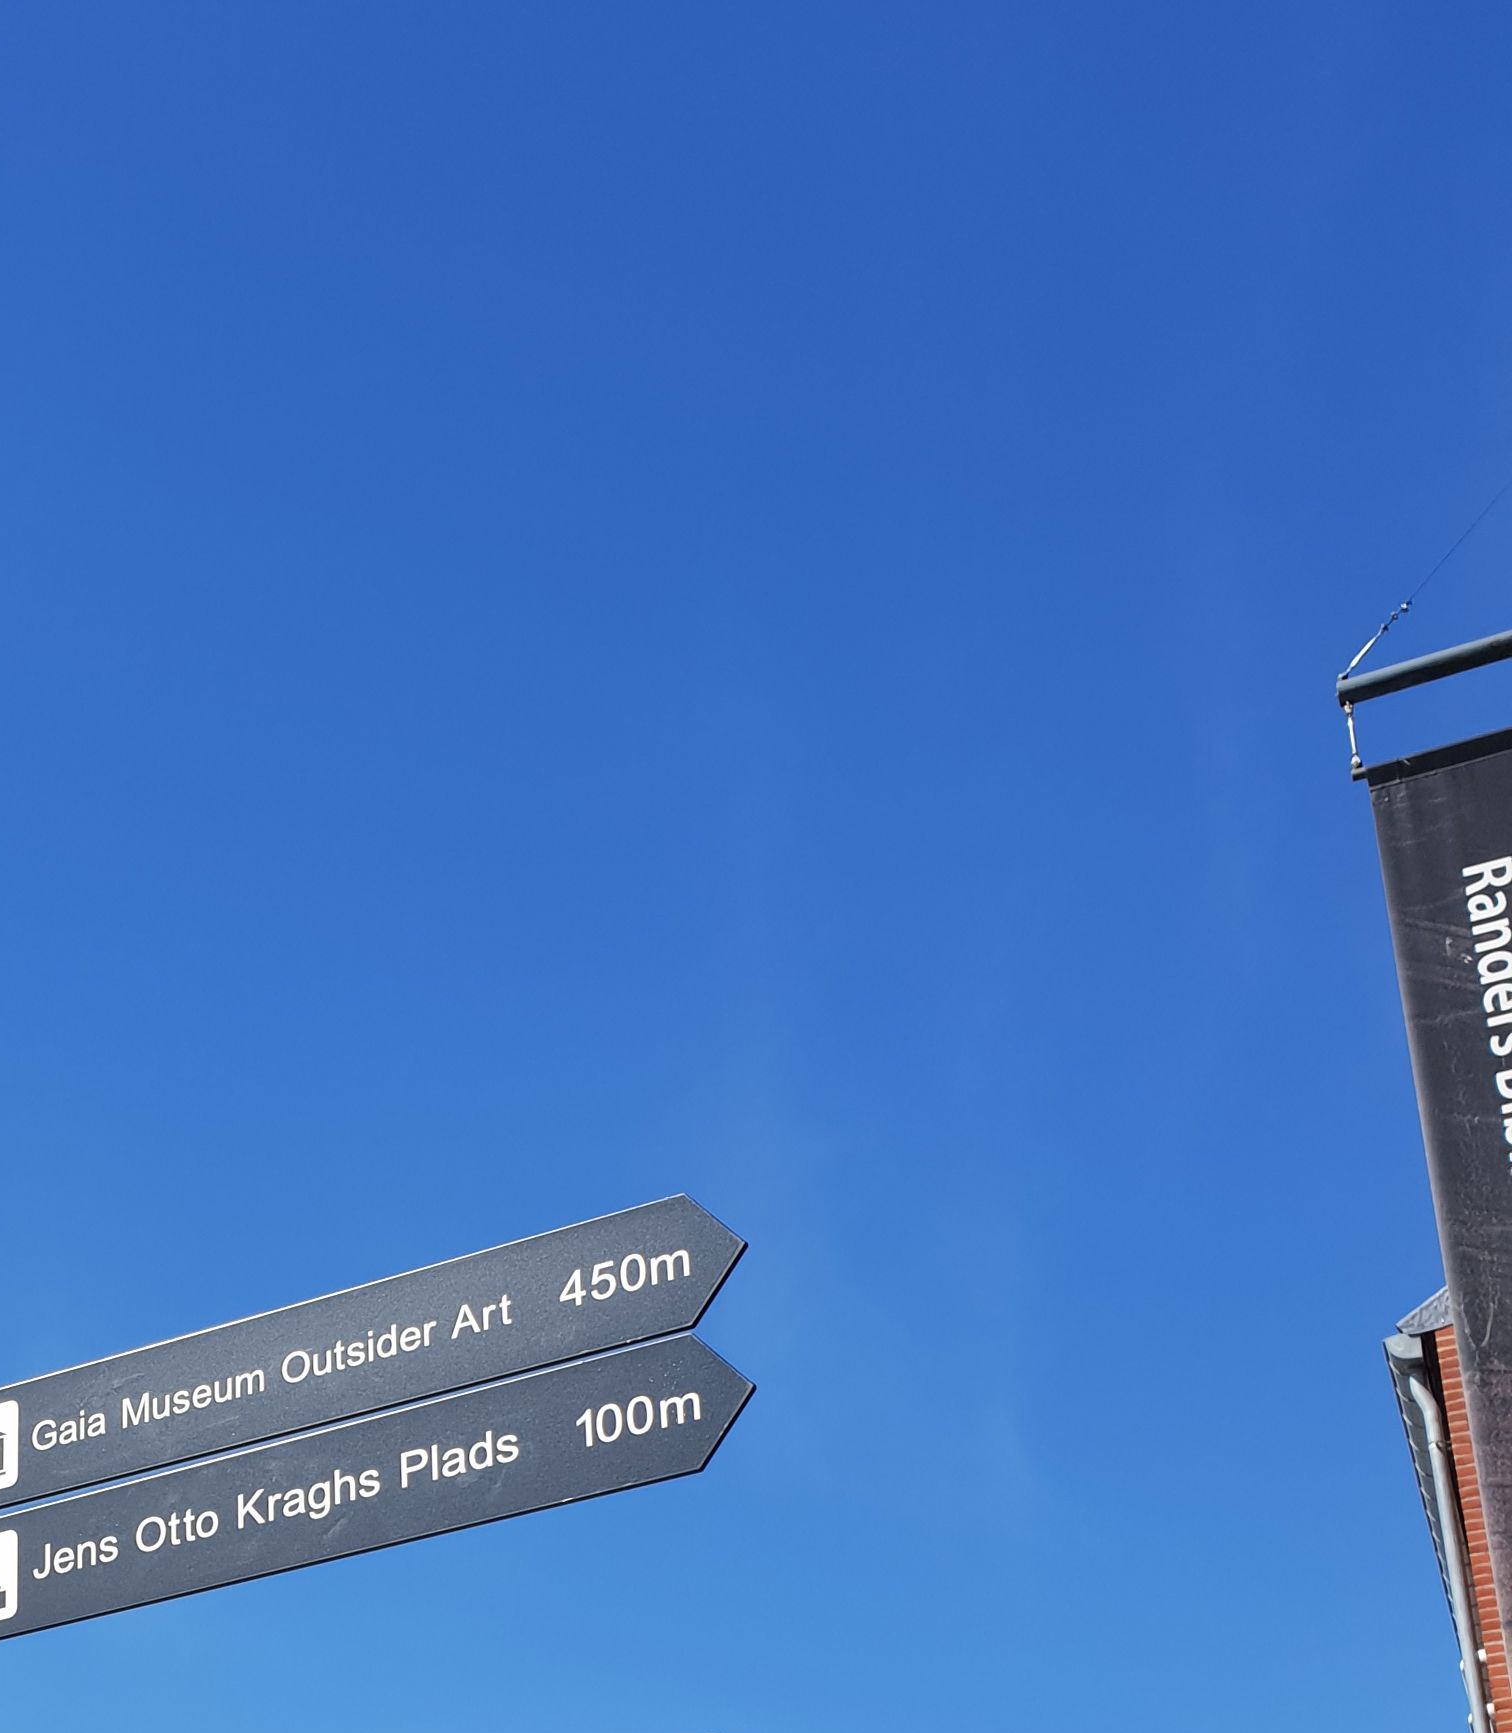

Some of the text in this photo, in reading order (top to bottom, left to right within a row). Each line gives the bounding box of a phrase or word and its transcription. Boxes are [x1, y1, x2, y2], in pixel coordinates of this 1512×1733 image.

[31, 1249, 691, 1451] Gaia Museum Outsider Art 450m
[32, 1392, 701, 1580] Jens Otto Kraghs Plads 100m
